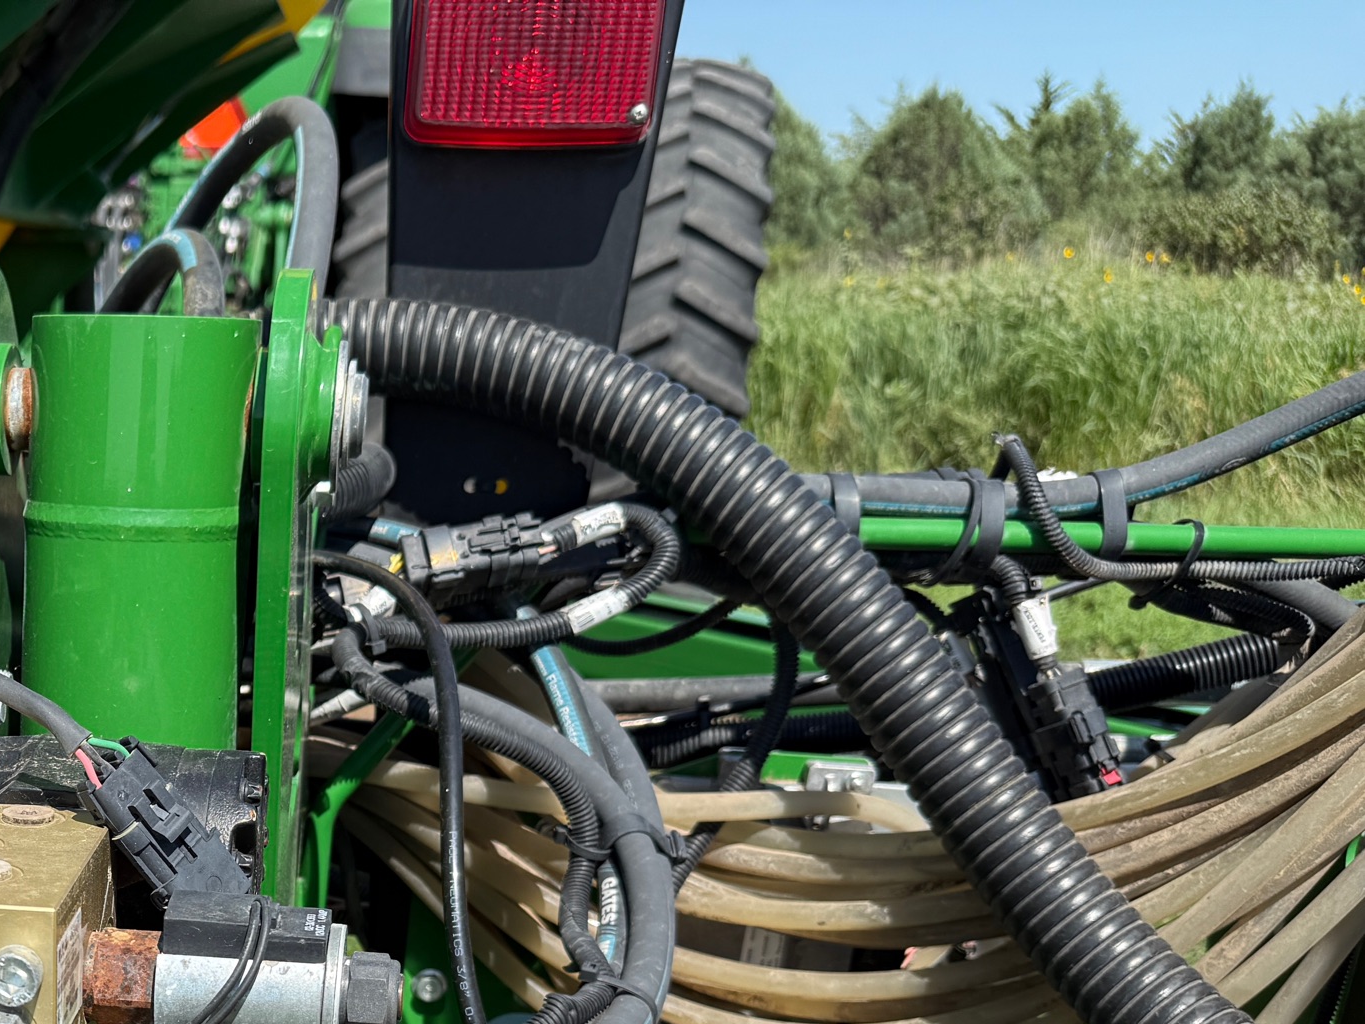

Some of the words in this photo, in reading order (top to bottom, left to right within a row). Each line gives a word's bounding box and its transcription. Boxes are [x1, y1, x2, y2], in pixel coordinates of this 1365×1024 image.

[545, 674, 564, 707] Flame
[559, 704, 582, 750] Resista
[448, 871, 465, 957] PNEUMATICS
[600, 876, 618, 922] GATES
